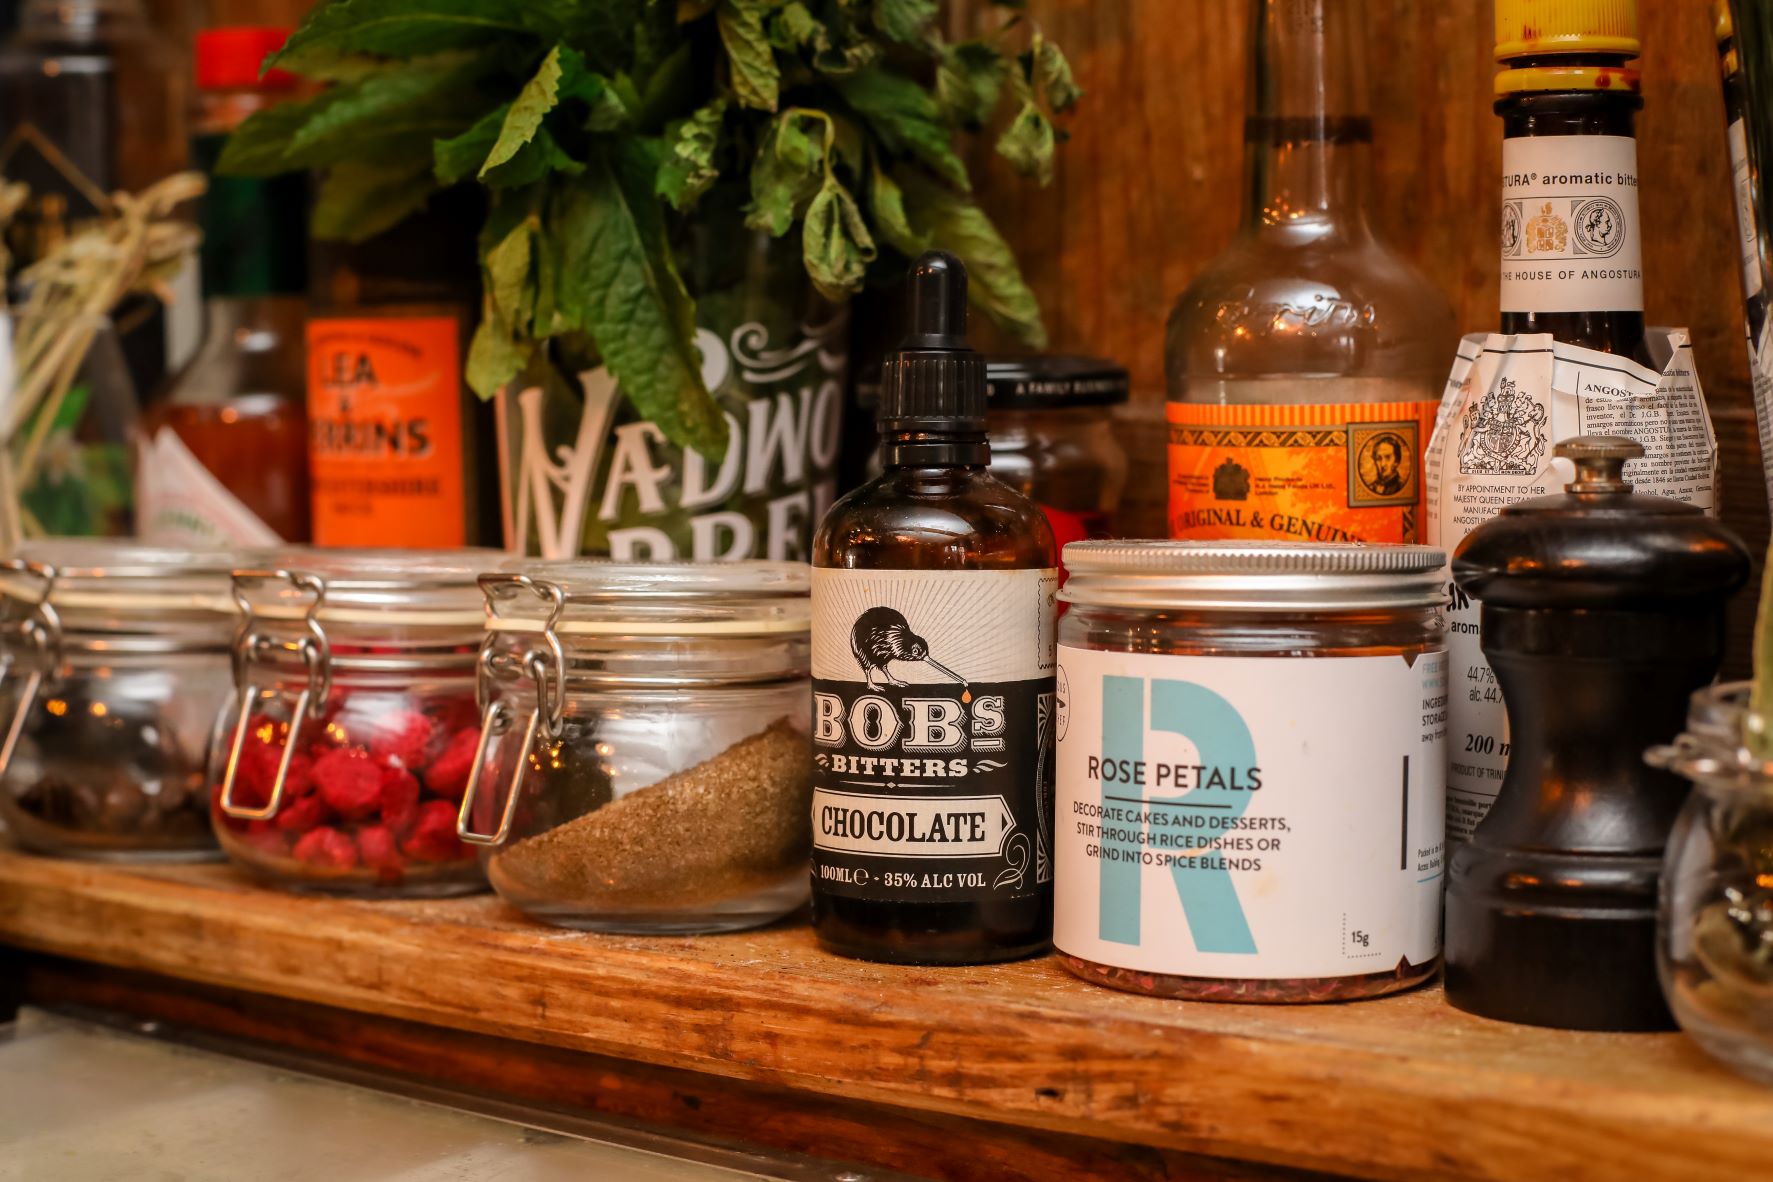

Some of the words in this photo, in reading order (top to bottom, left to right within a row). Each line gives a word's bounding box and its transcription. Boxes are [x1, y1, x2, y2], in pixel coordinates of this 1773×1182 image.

[1542, 172, 1613, 185] aromatic
[1617, 173, 1638, 187] bitte
[1515, 271, 1552, 281] HOUSE
[1558, 270, 1575, 280] OF
[1586, 413, 1615, 421] inventor,
[1586, 421, 1613, 429] amargos
[1644, 420, 1659, 428] pero
[1622, 469, 1660, 477] riginalmente
[1458, 484, 1464, 492] BY
[1465, 485, 1515, 494] APPOINTMENT
[1517, 486, 1529, 494] TO
[1530, 486, 1545, 495] HER
[1453, 494, 1478, 504] MAJESTY
[1479, 496, 1505, 505] QUEEN
[1463, 506, 1500, 515] MANUFACT
[1251, 511, 1264, 529] &
[1269, 513, 1367, 542] GENUIN
[1453, 516, 1489, 525] ANGOSTUR
[1451, 621, 1479, 635] arom
[1467, 665, 1495, 684] 44.7%
[1469, 686, 1483, 702] alc.
[1465, 733, 1495, 755] 200
[831, 754, 969, 778] BITTERS
[1088, 755, 1147, 786] ROSE
[1156, 761, 1263, 792] PETALS
[1451, 762, 1475, 777] PRODUCT
[1476, 767, 1485, 778] OF
[821, 805, 986, 843] CHOCOLATE
[1073, 800, 1124, 823] DECORATE
[1125, 809, 1169, 827] CAKES
[1171, 814, 1205, 829] AND
[1209, 816, 1292, 833] DESSERTS,
[1076, 822, 1095, 837] STIR
[1097, 826, 1157, 847] THROUGH
[1160, 834, 1193, 849] RICE
[1197, 836, 1254, 851] DISHES
[1257, 838, 1281, 851] OR
[1085, 844, 1120, 862] GRIND
[1122, 849, 1153, 865] INTO
[1156, 853, 1196, 870] SPICE
[1200, 856, 1262, 872] BLENDS
[820, 864, 852, 883] 100ML
[884, 872, 918, 888] 35%
[920, 873, 953, 888] ALC
[956, 872, 986, 888] VOL
[1351, 930, 1370, 947] 15g
